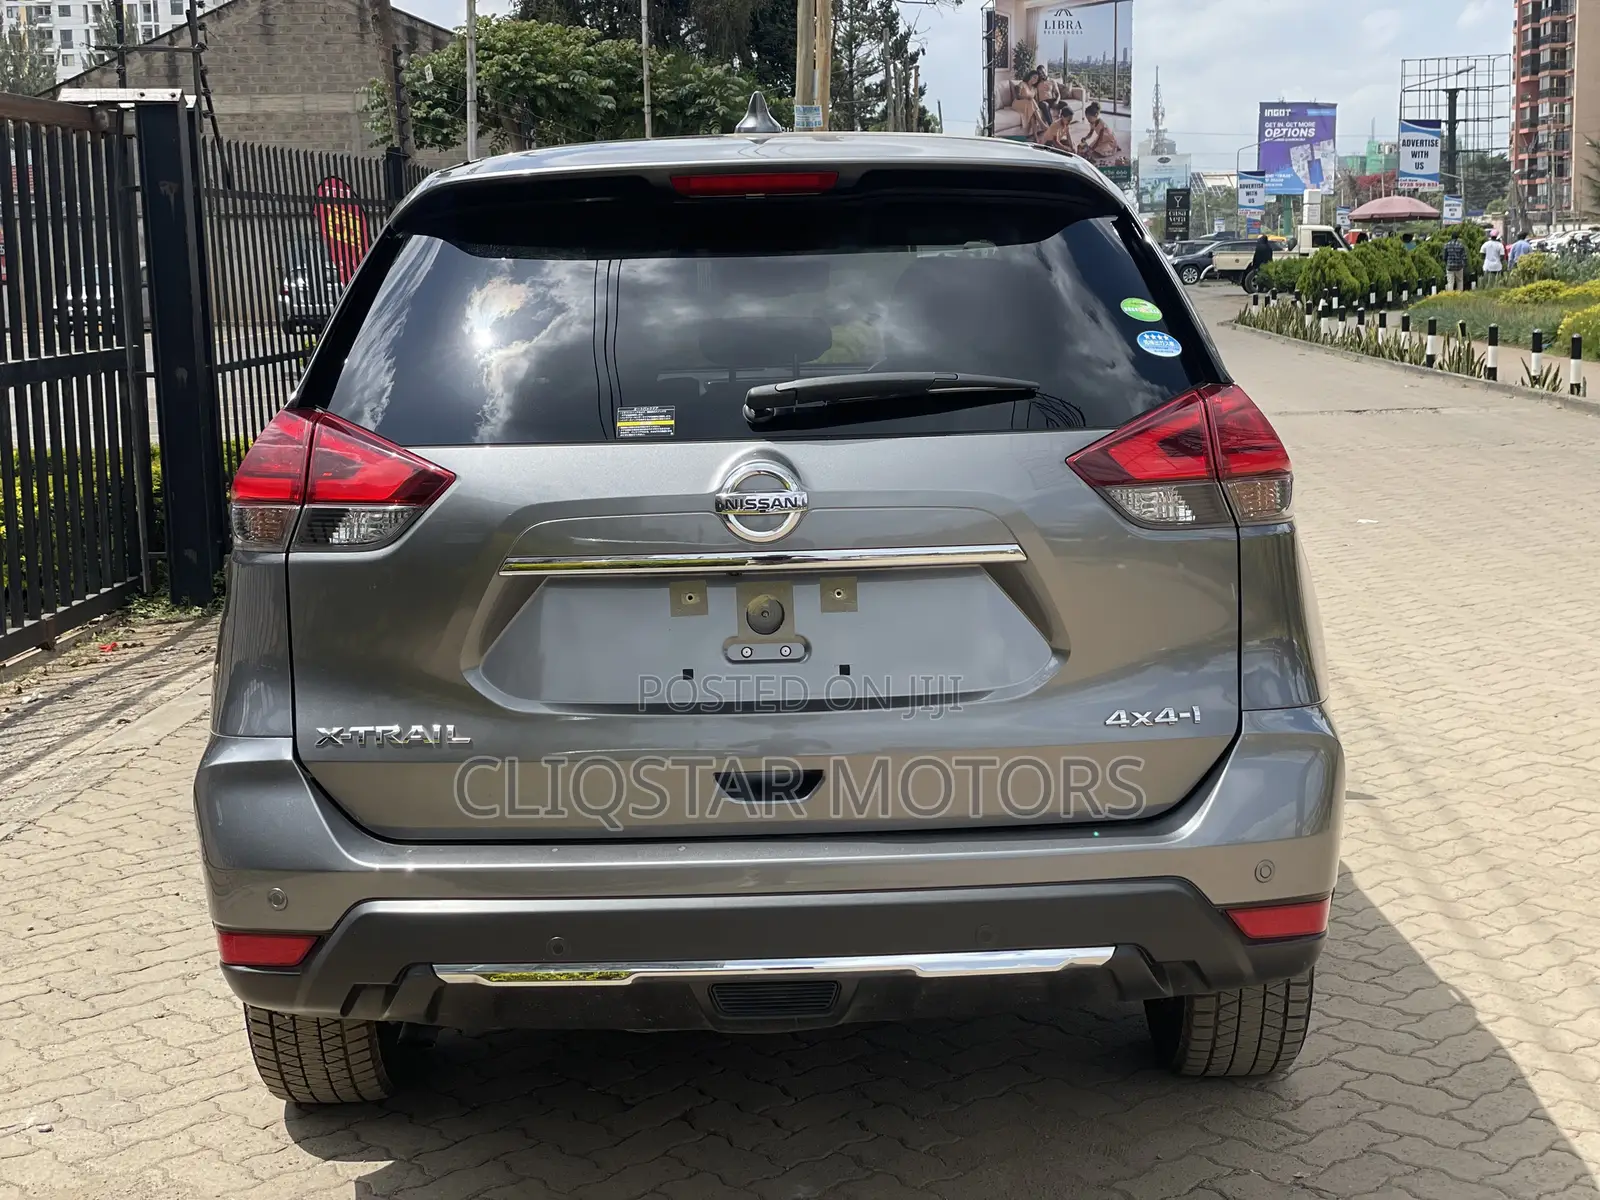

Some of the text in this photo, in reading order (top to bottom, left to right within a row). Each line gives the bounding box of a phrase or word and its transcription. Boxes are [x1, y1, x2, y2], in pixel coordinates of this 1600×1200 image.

[1044, 20, 1082, 30] LIBRA
[1264, 127, 1316, 138] OPTIONS
[1401, 139, 1439, 147] ADVERTISE
[1411, 150, 1429, 159] WITH
[1414, 162, 1425, 170] US
[725, 496, 798, 510] NISSAN
[315, 724, 472, 747] X-TRAIL
